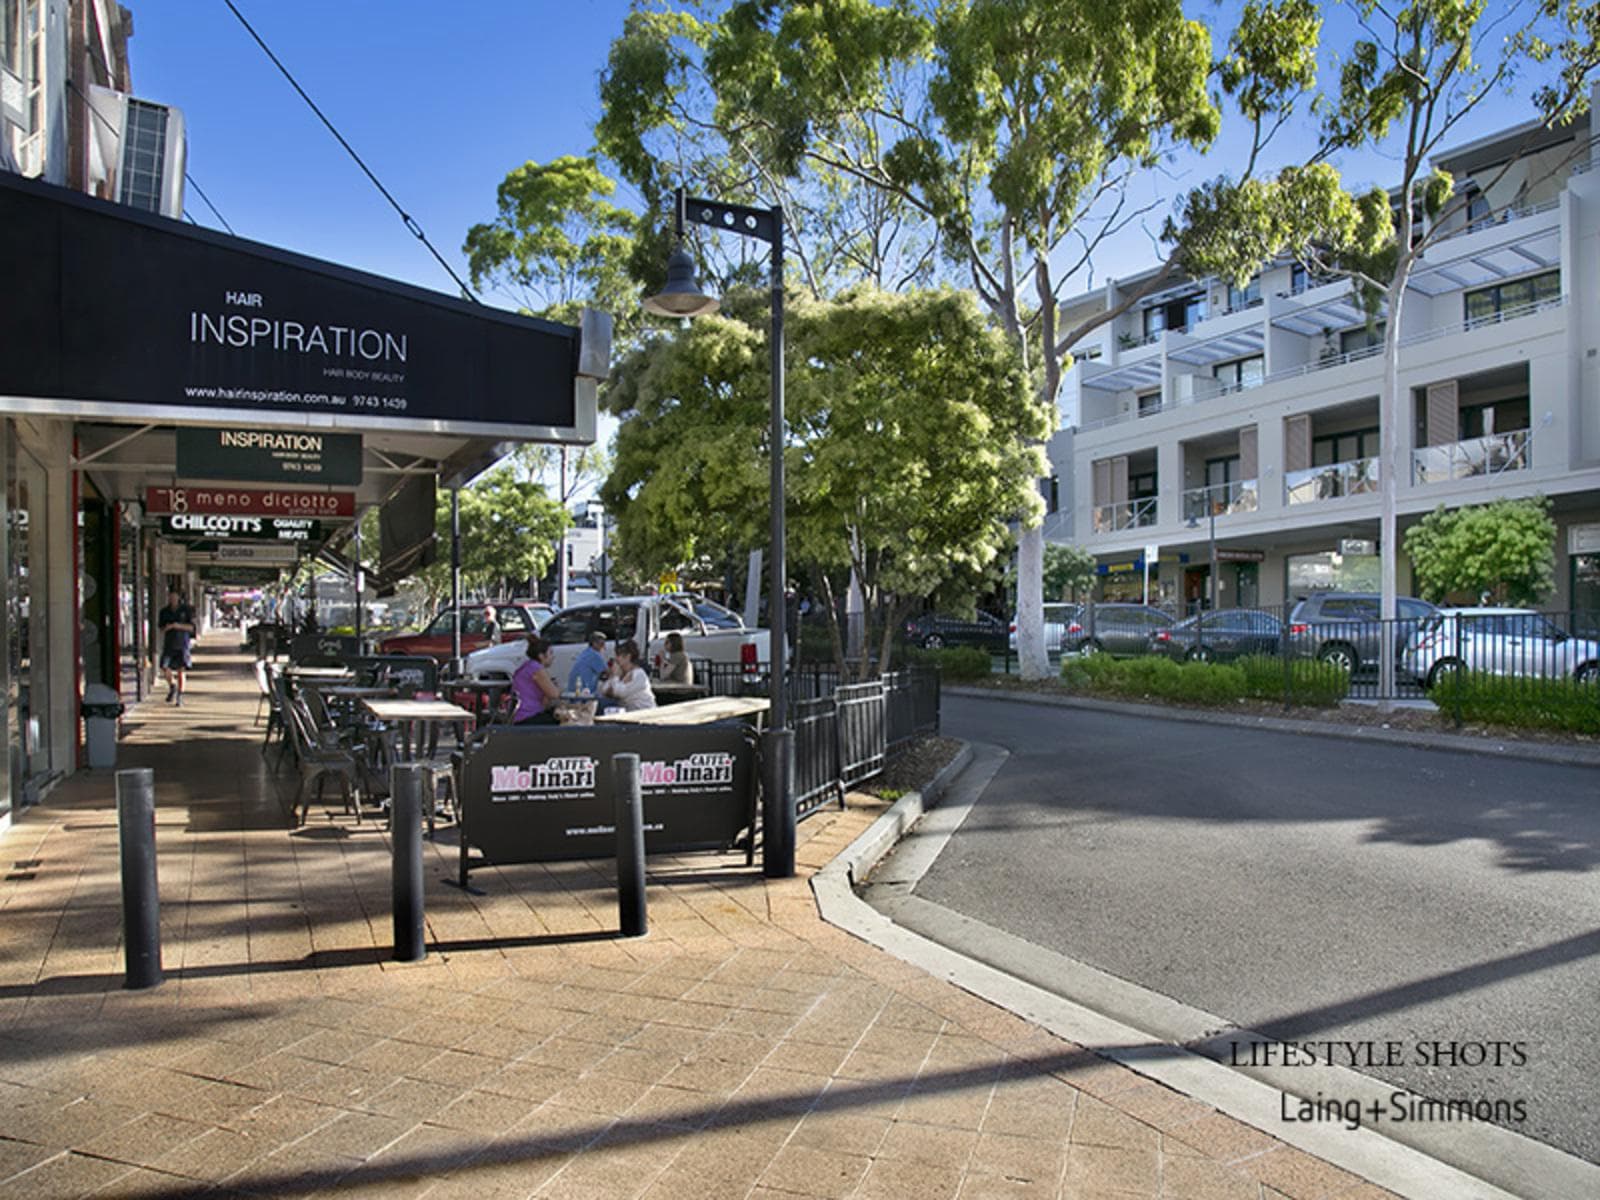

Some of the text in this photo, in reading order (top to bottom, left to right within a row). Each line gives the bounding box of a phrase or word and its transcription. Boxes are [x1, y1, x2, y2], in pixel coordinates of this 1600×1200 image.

[225, 291, 263, 307] HAIR
[190, 311, 408, 362] INSPIRATION
[185, 387, 346, 405] www.hairinspiration.com.au
[220, 431, 322, 451] INSPIRATION
[197, 492, 251, 507] meno
[263, 492, 339, 509] diciotto
[273, 519, 313, 530] QUALITY
[492, 765, 594, 791] Molinari
[641, 760, 733, 786] Molinari
